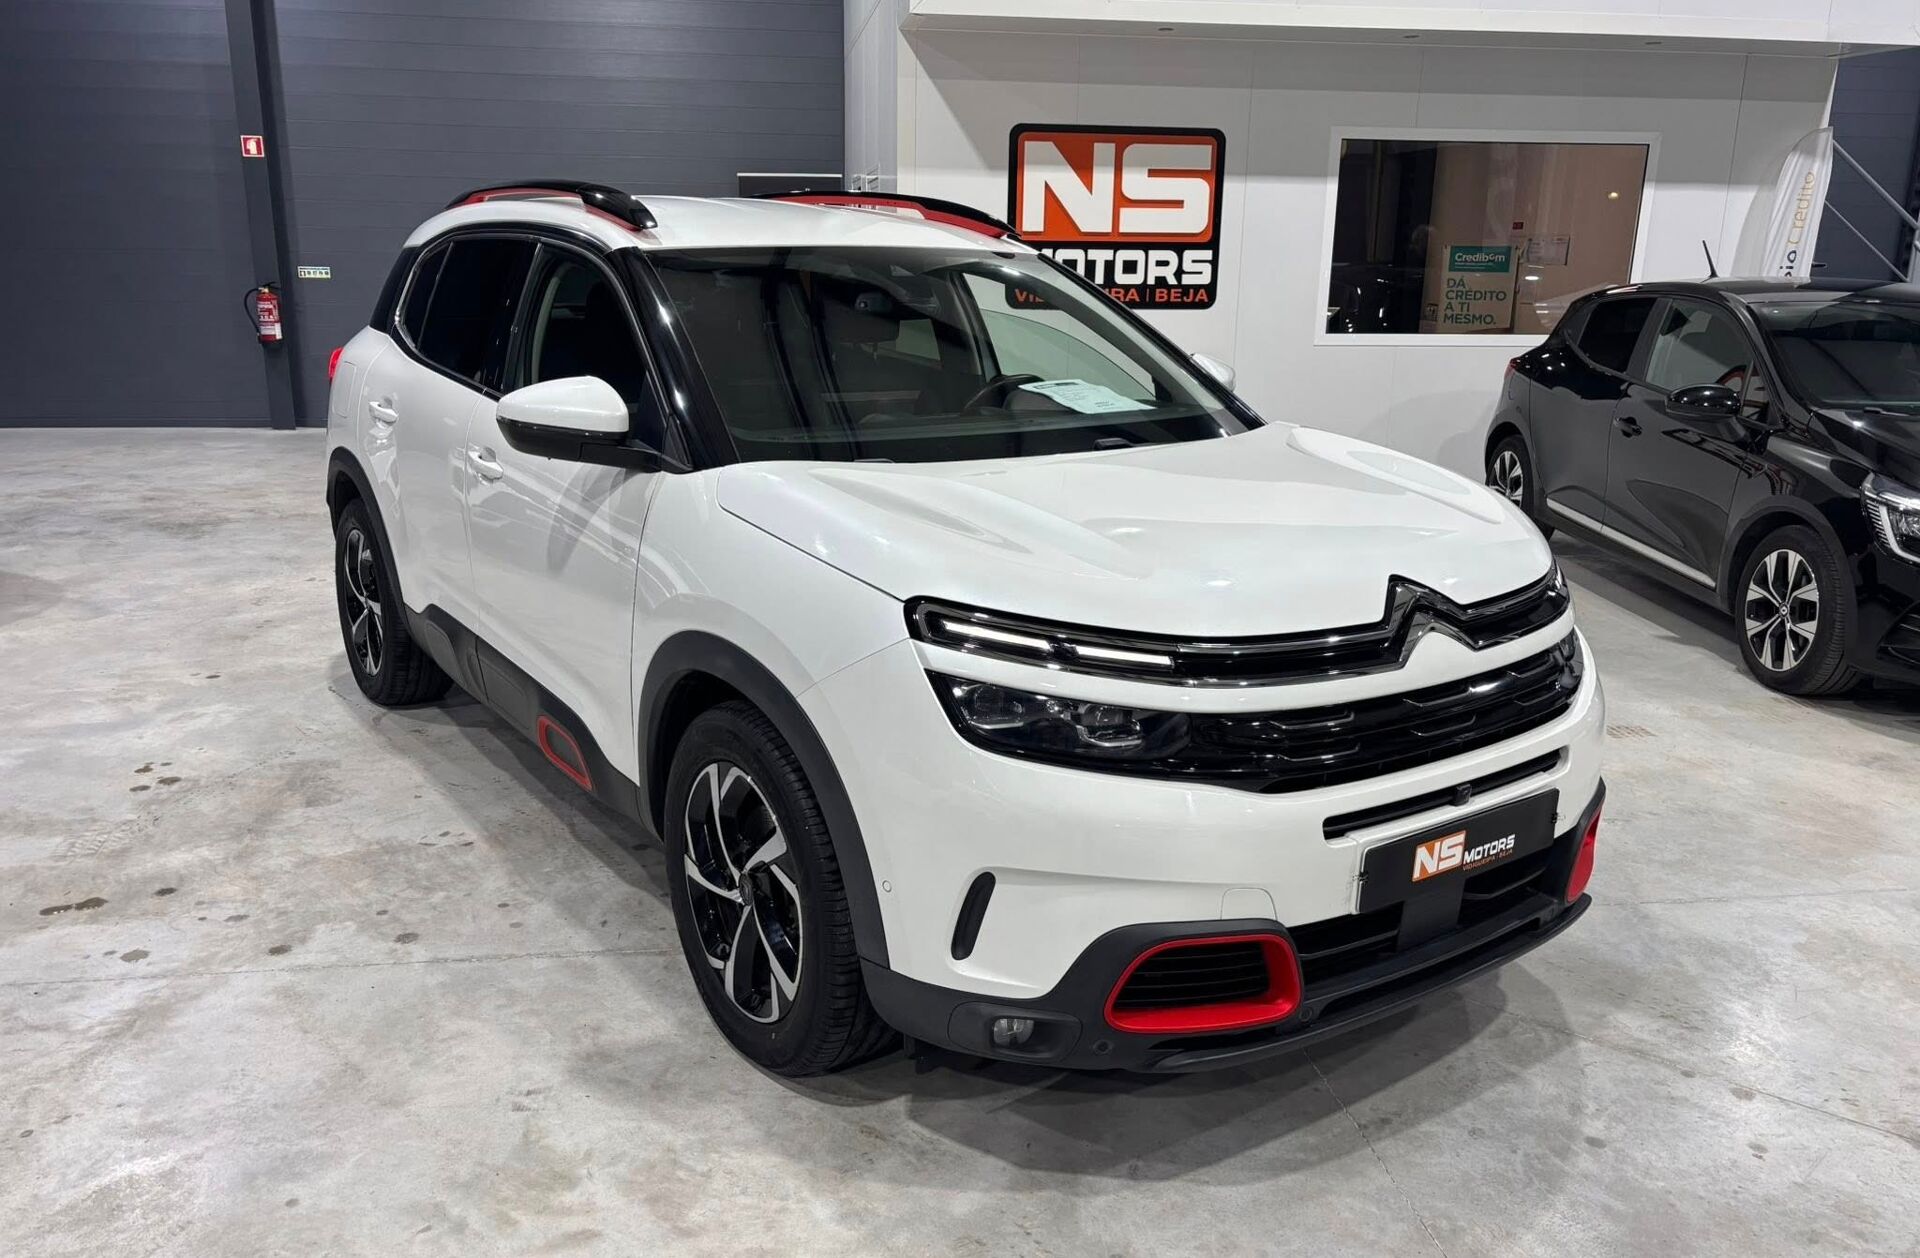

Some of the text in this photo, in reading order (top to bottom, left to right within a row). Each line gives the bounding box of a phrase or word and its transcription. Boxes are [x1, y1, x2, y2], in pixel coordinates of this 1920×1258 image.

[1022, 140, 1213, 233] NS
[1040, 248, 1213, 285] OTORS
[1155, 288, 1208, 303] BEJA
[1444, 301, 1470, 313] A TI
[1443, 312, 1497, 325] MESMO.
[1413, 831, 1466, 879] NS
[1463, 833, 1516, 865] MOTORS
